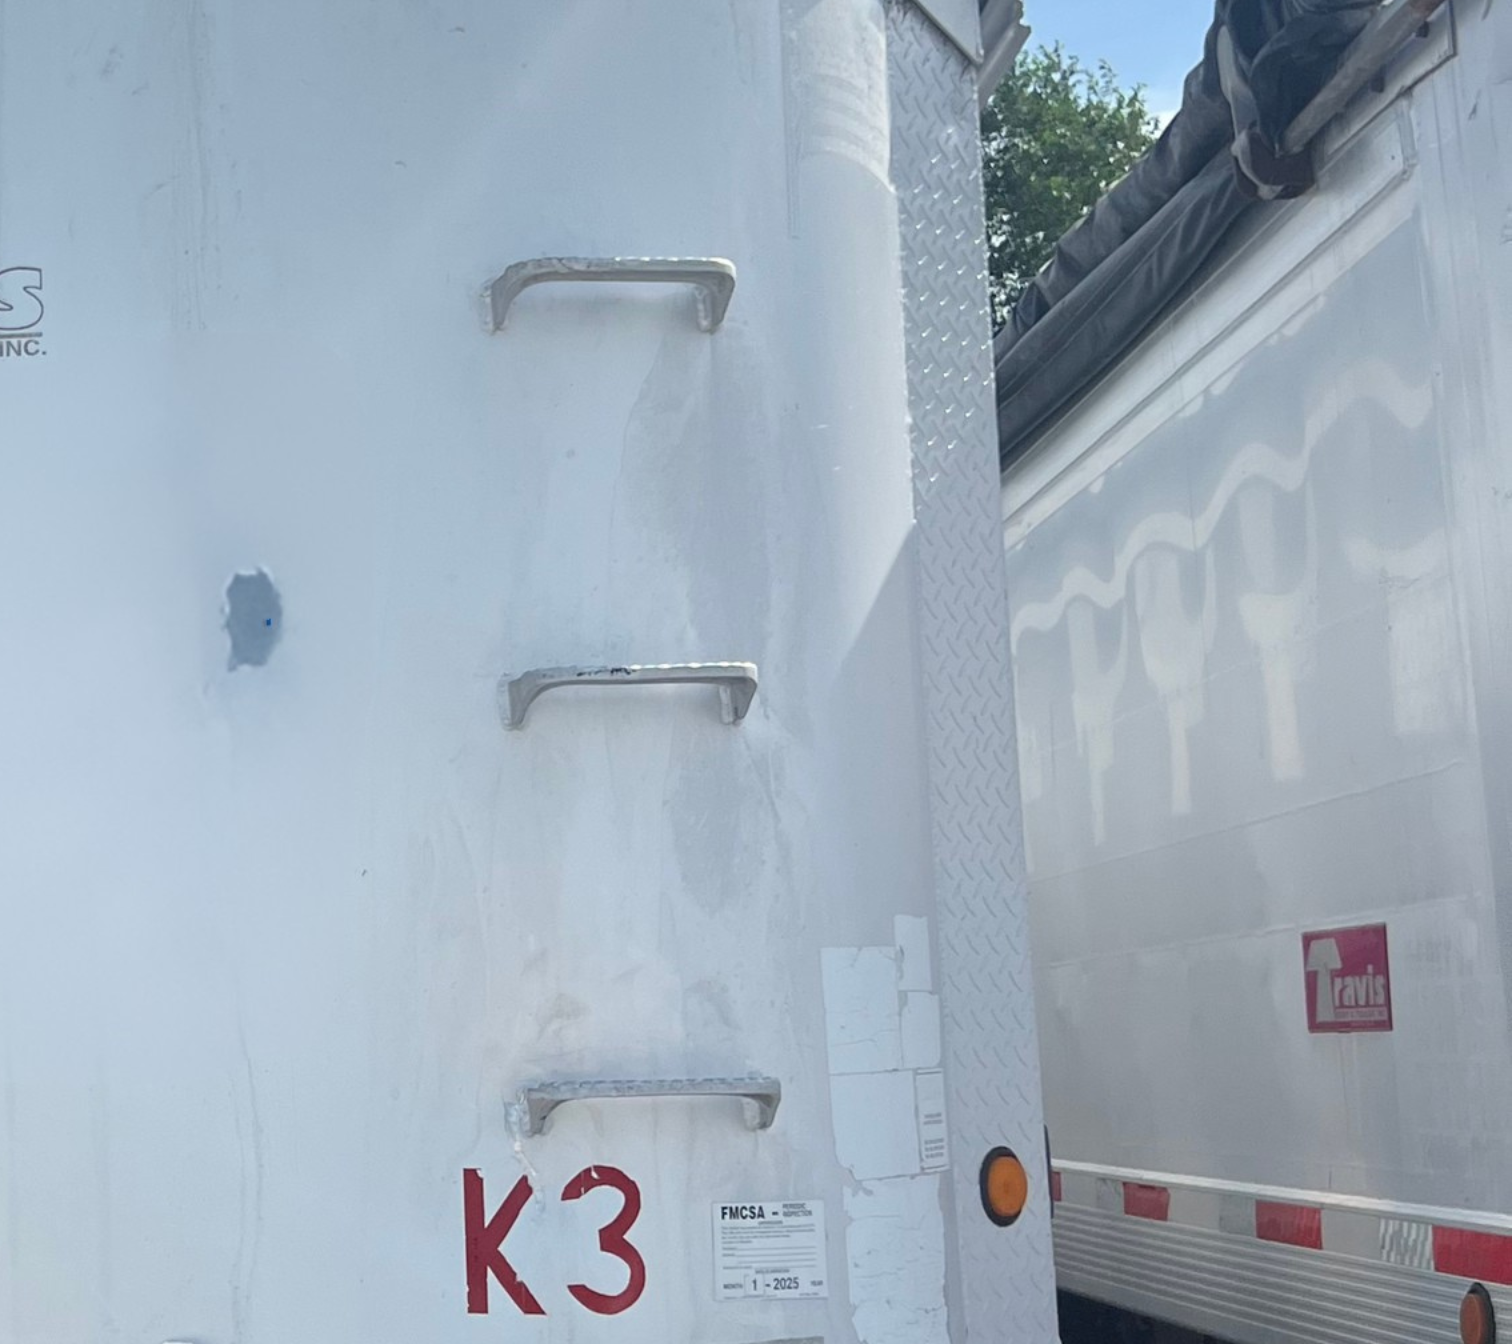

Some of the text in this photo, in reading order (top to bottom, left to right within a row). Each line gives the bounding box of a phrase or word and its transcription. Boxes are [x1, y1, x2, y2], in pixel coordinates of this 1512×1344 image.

[1306, 936, 1386, 1024] Travis
[720, 1205, 766, 1220] FMCSA
[751, 1277, 758, 1292] 1
[772, 1276, 800, 1291] 2025
